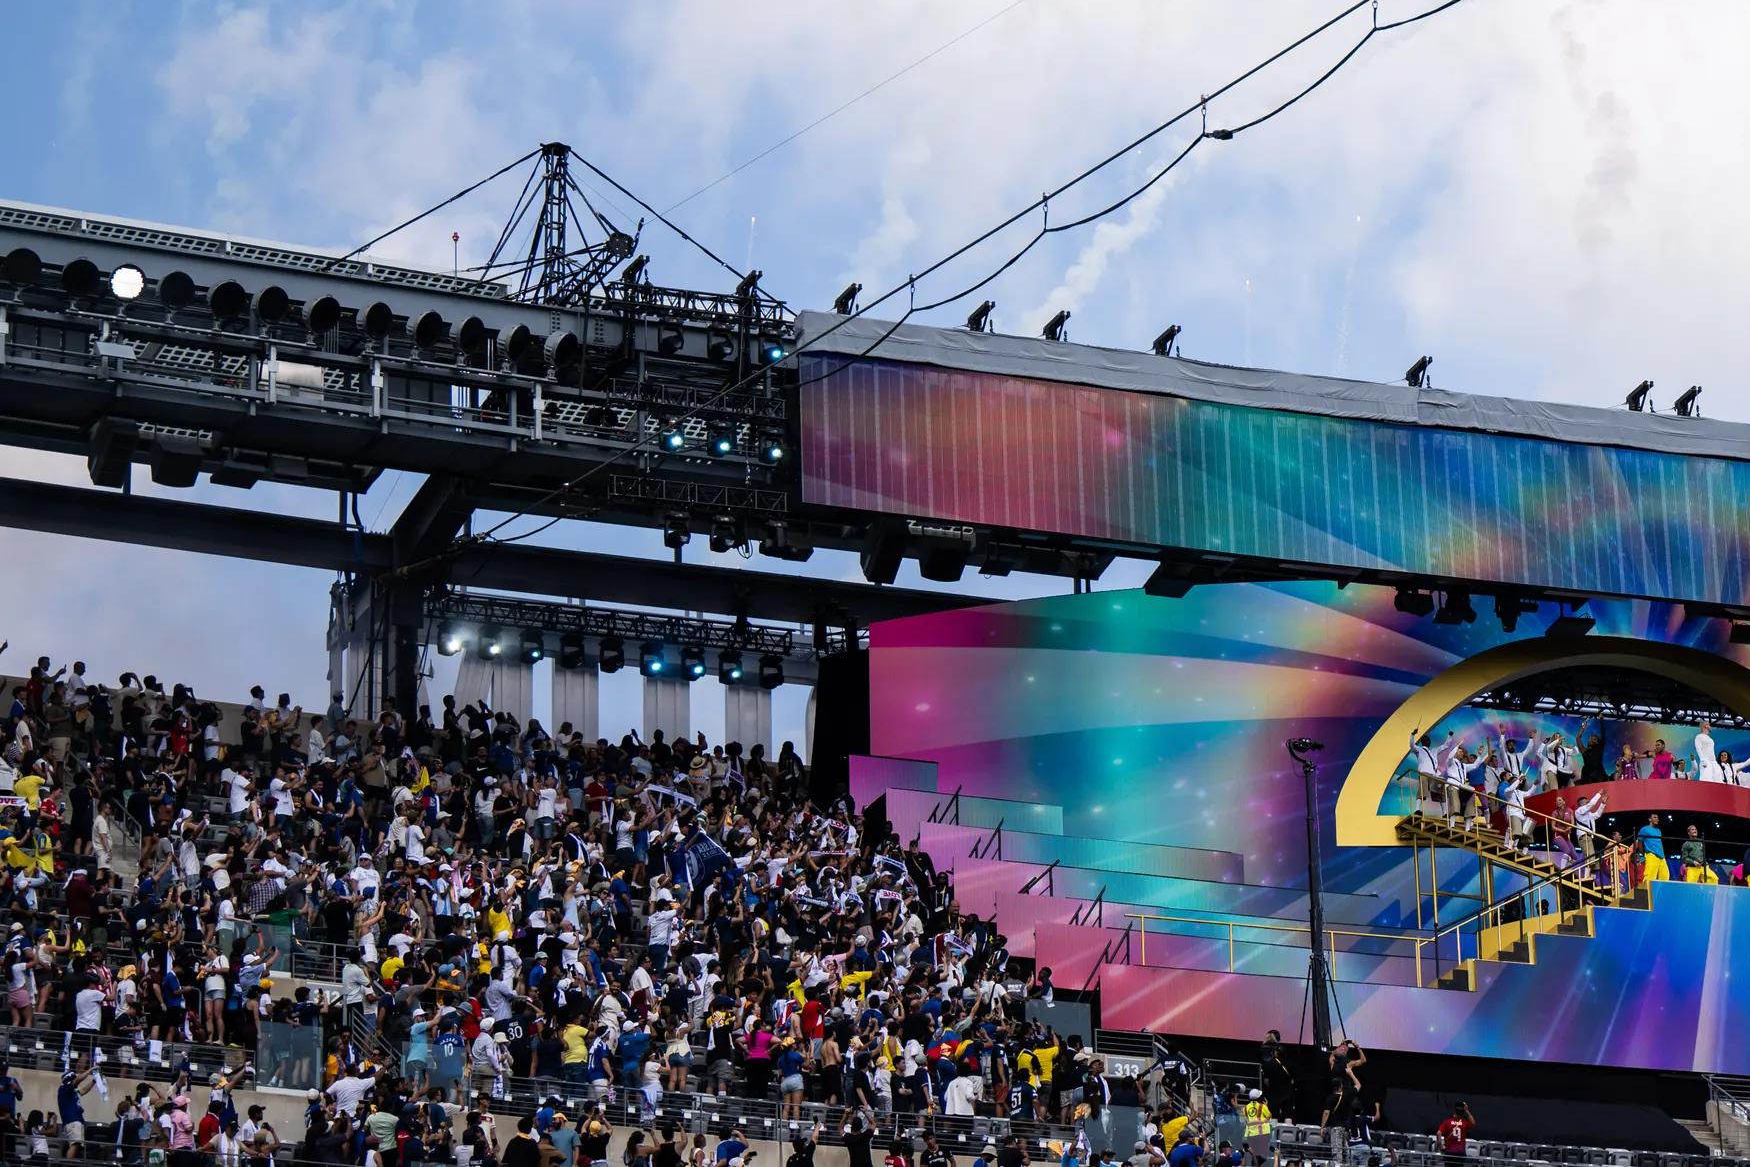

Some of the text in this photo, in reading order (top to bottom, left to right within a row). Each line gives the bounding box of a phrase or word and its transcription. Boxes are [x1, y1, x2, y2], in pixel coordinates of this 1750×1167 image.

[507, 1026, 523, 1040] 30
[444, 1043, 454, 1057] 10
[1115, 1063, 1139, 1078] 313
[1011, 1092, 1022, 1109] 51
[1452, 1127, 1462, 1142] 9
